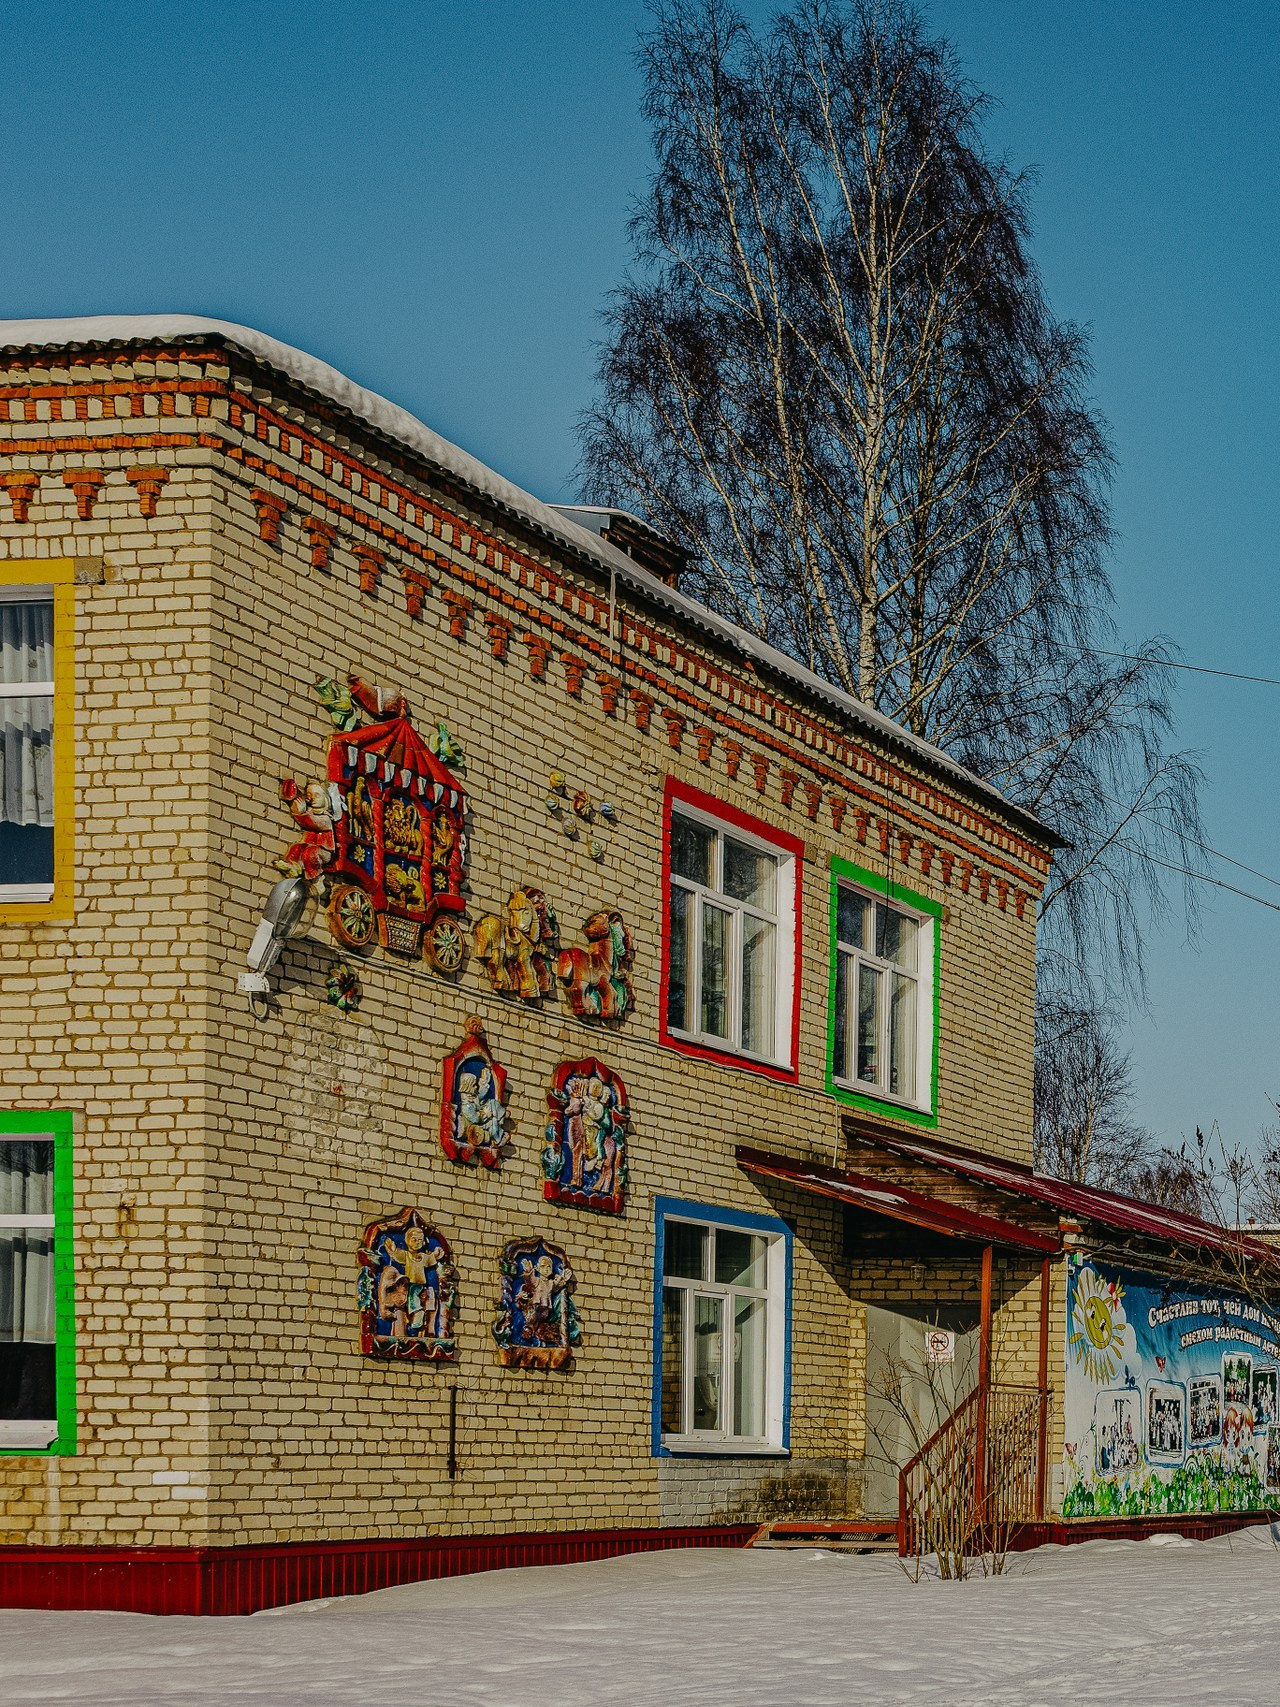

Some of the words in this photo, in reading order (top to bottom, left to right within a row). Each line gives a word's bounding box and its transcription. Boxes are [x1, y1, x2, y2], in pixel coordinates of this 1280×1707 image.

[1147, 1300, 1199, 1328] Счастлив
[1200, 1299, 1221, 1318] тот,
[1222, 1298, 1242, 1317] чей
[1242, 1304, 1260, 1323] дом
[1180, 1326, 1213, 1348] смехом
[1214, 1325, 1262, 1347] радостным
